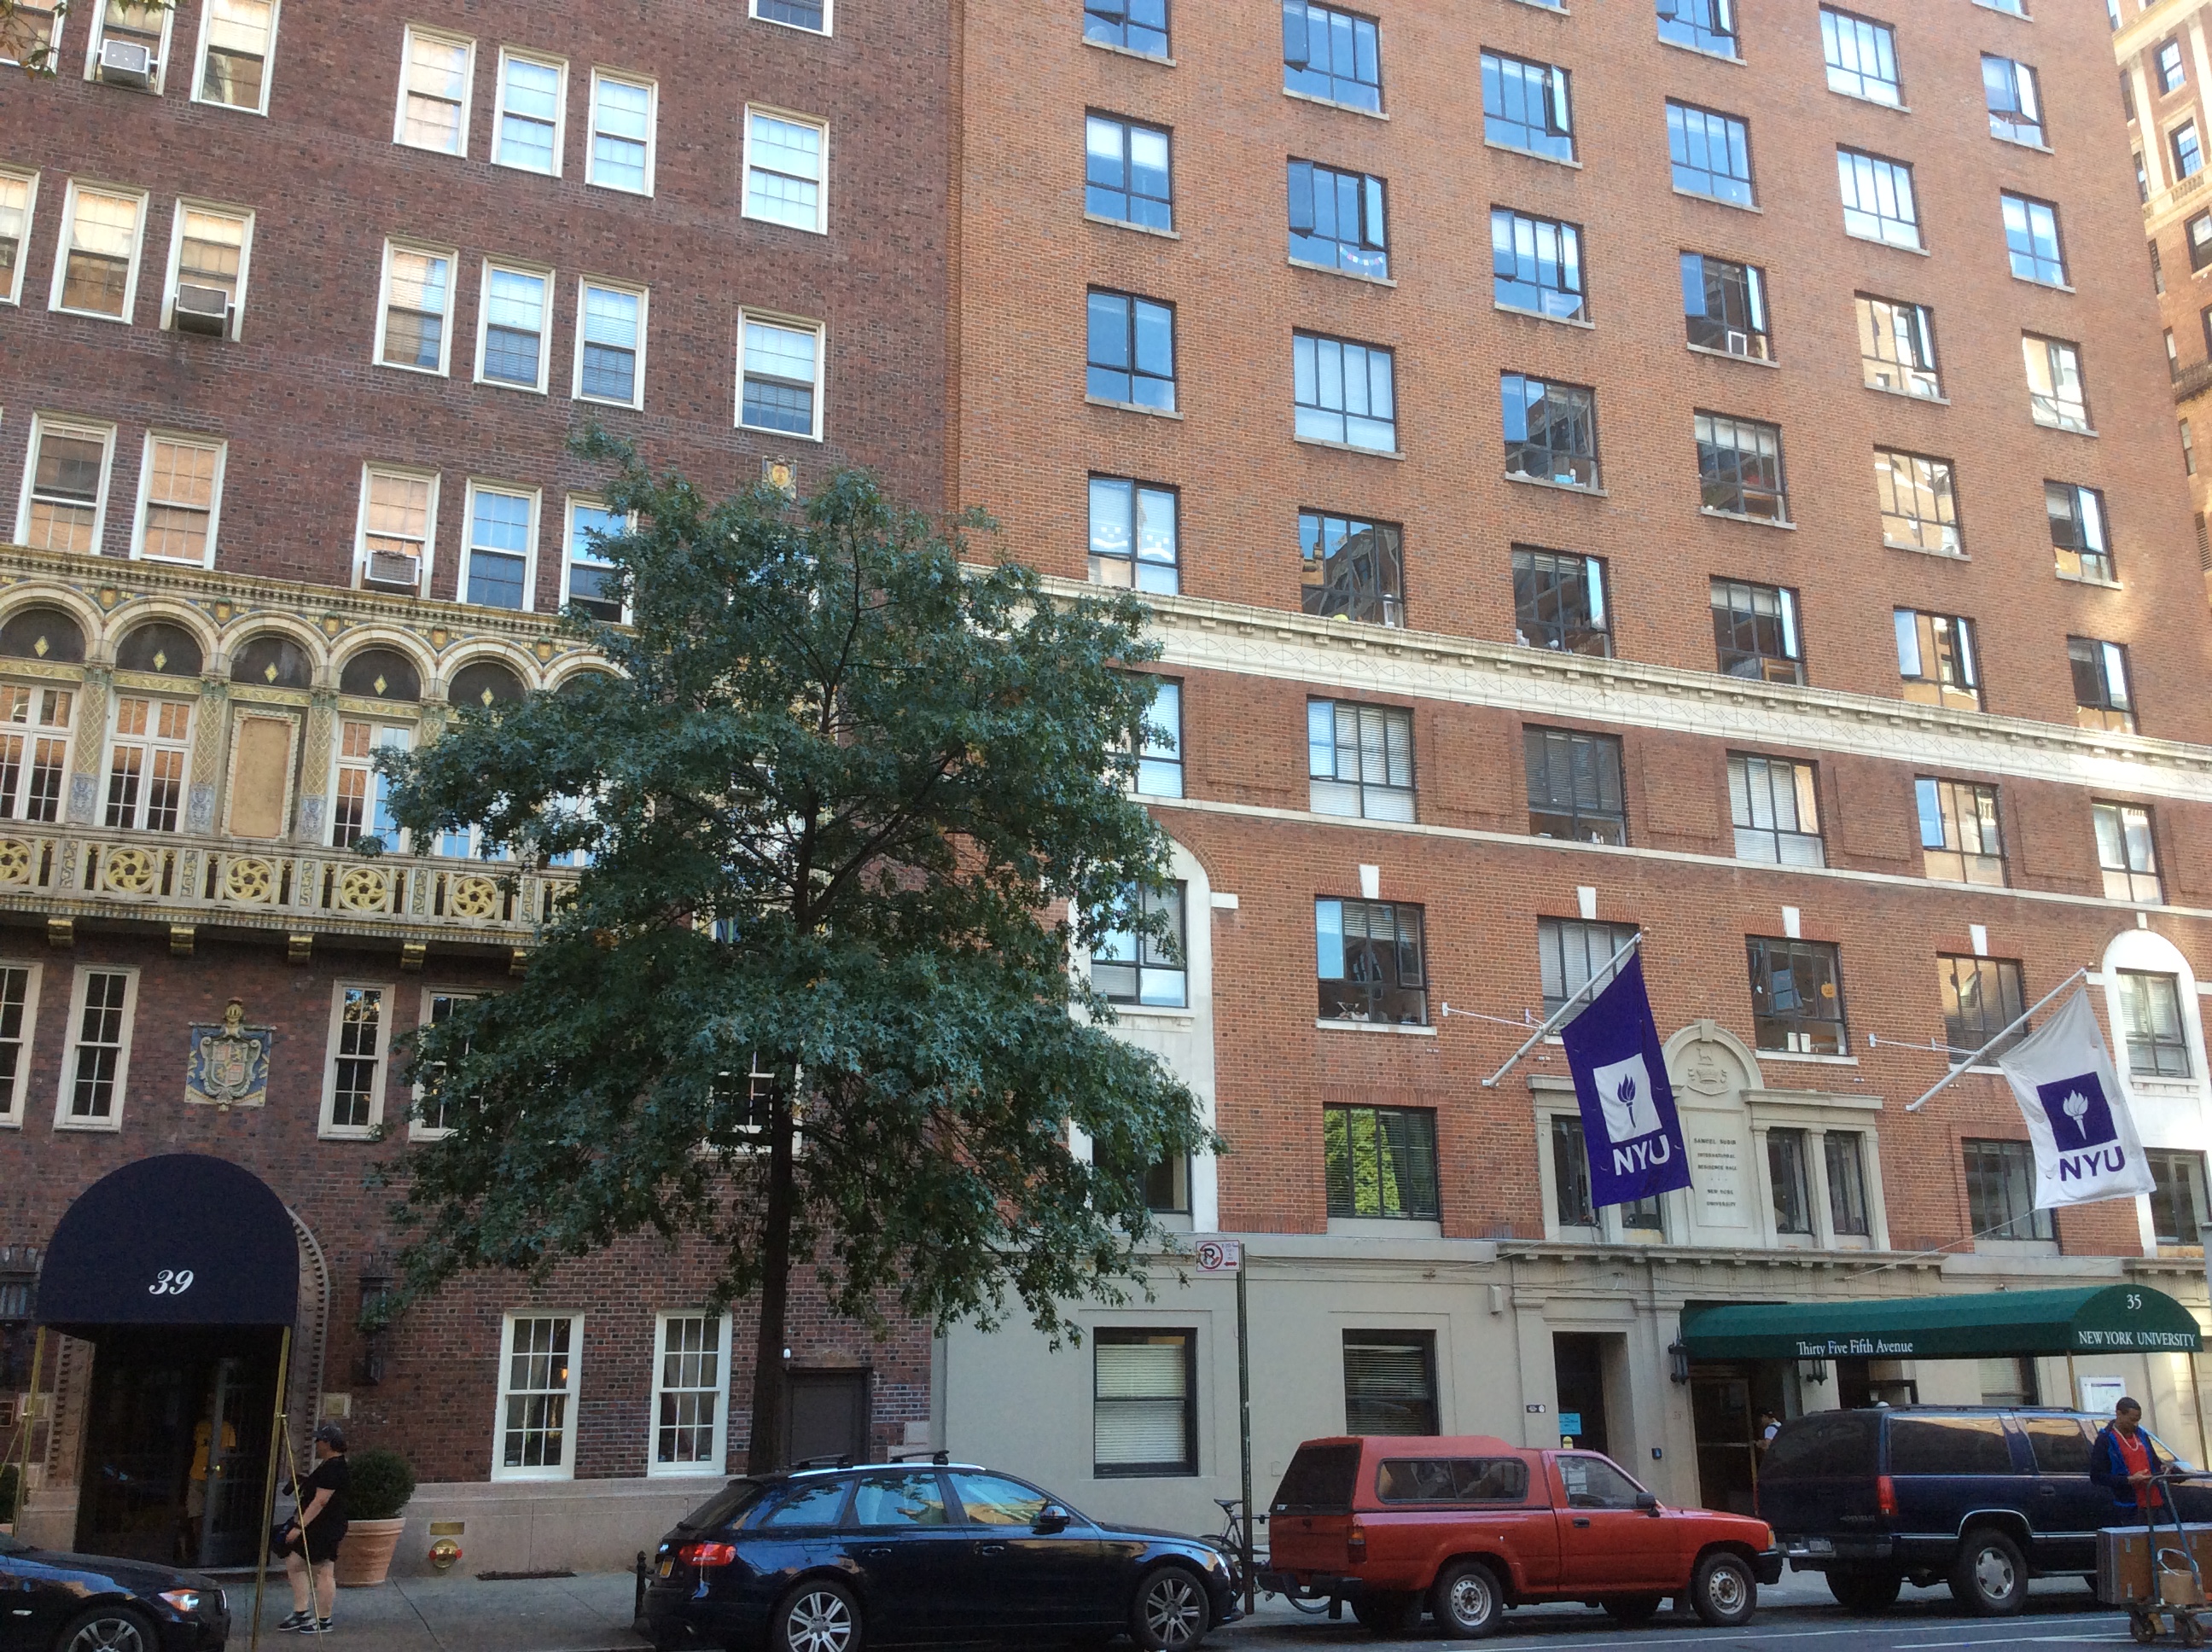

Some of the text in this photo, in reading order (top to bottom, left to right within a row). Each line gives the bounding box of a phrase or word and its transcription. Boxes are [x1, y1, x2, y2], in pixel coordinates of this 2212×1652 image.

[1612, 1134, 1670, 1176] NYU
[2059, 1145, 2126, 1182] NYU
[148, 1269, 195, 1295] 39
[2126, 1294, 2142, 1310] 35
[1796, 1338, 1913, 1358] Thirty Five Fifth Avenue
[2078, 1330, 2196, 1347] NEW YORK UNIVERSITY
